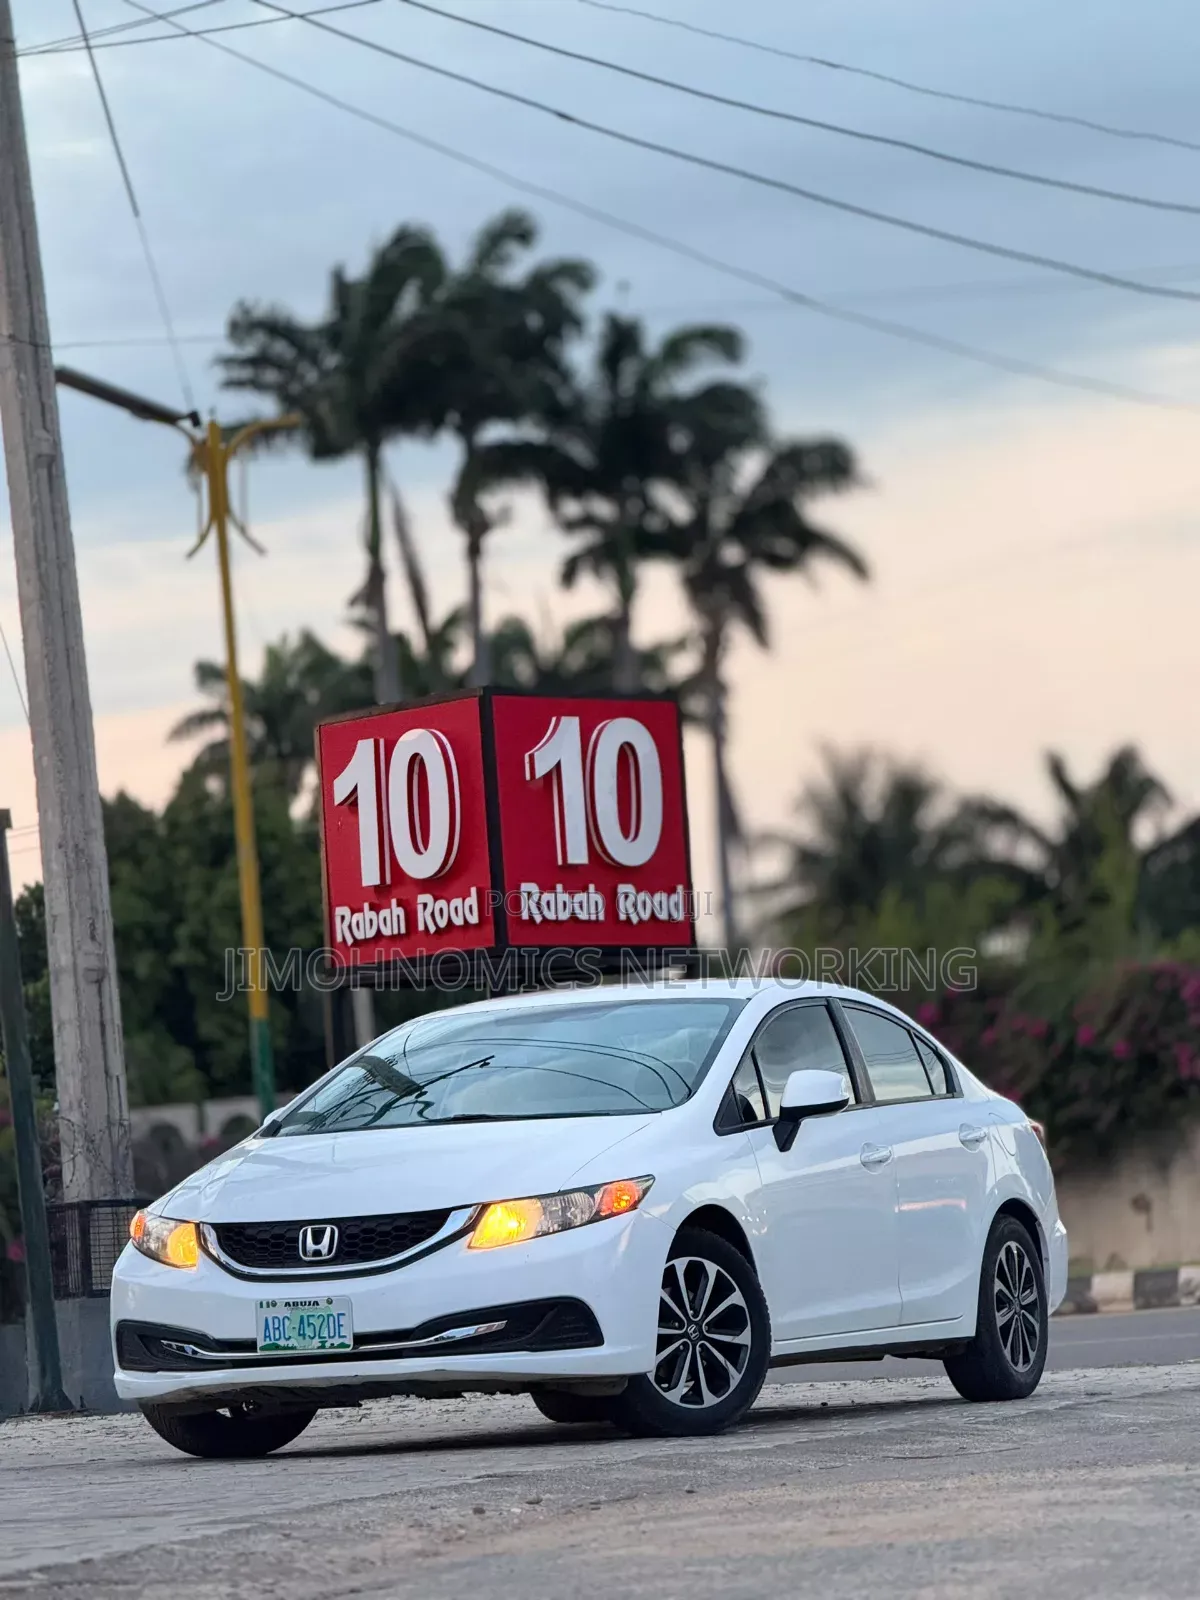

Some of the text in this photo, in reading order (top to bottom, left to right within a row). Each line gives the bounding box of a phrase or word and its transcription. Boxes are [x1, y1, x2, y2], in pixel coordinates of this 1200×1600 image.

[333, 728, 461, 887] 10
[525, 716, 663, 867] 10
[335, 886, 479, 946] Rabah Road
[520, 882, 685, 925] Rabah Road
[284, 1300, 320, 1308] ABUJA
